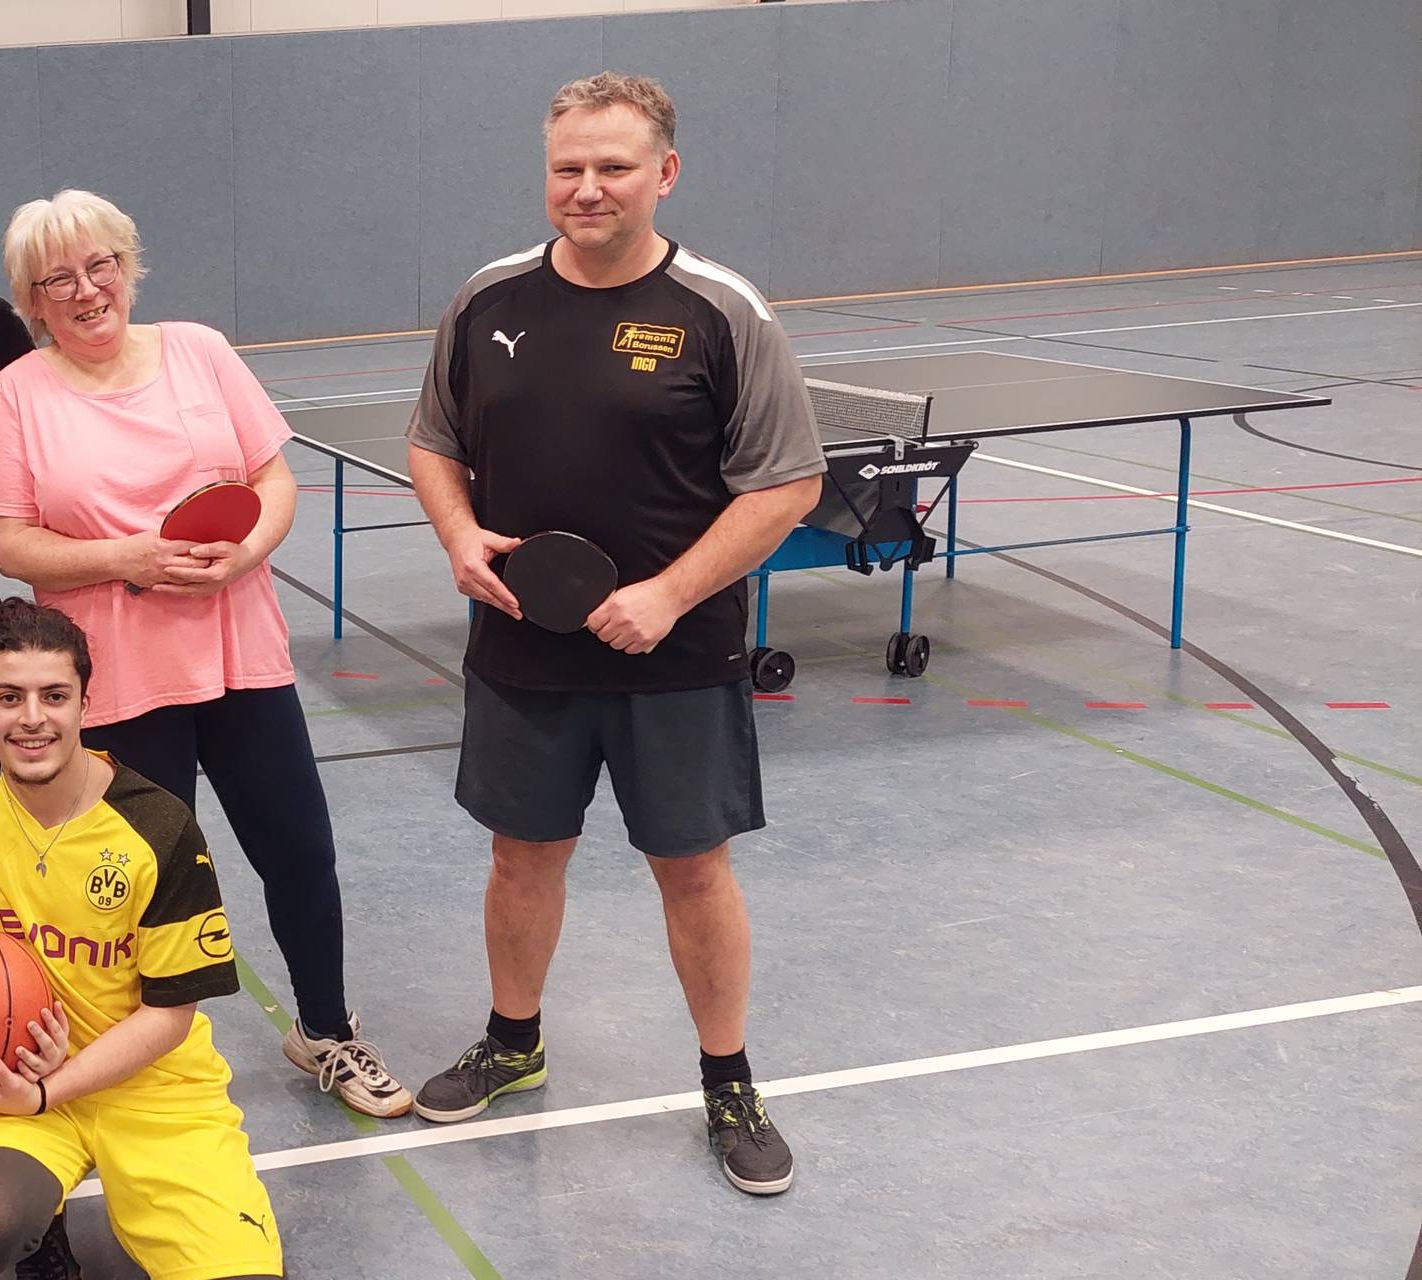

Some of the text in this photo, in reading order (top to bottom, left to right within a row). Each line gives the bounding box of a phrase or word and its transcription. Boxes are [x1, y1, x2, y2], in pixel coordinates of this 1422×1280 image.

[632, 340, 674, 353] Borussen
[630, 356, 657, 372] INGO
[880, 460, 939, 475] SCHILDKRÖT
[90, 868, 126, 898] BVB
[98, 896, 112, 906] 09
